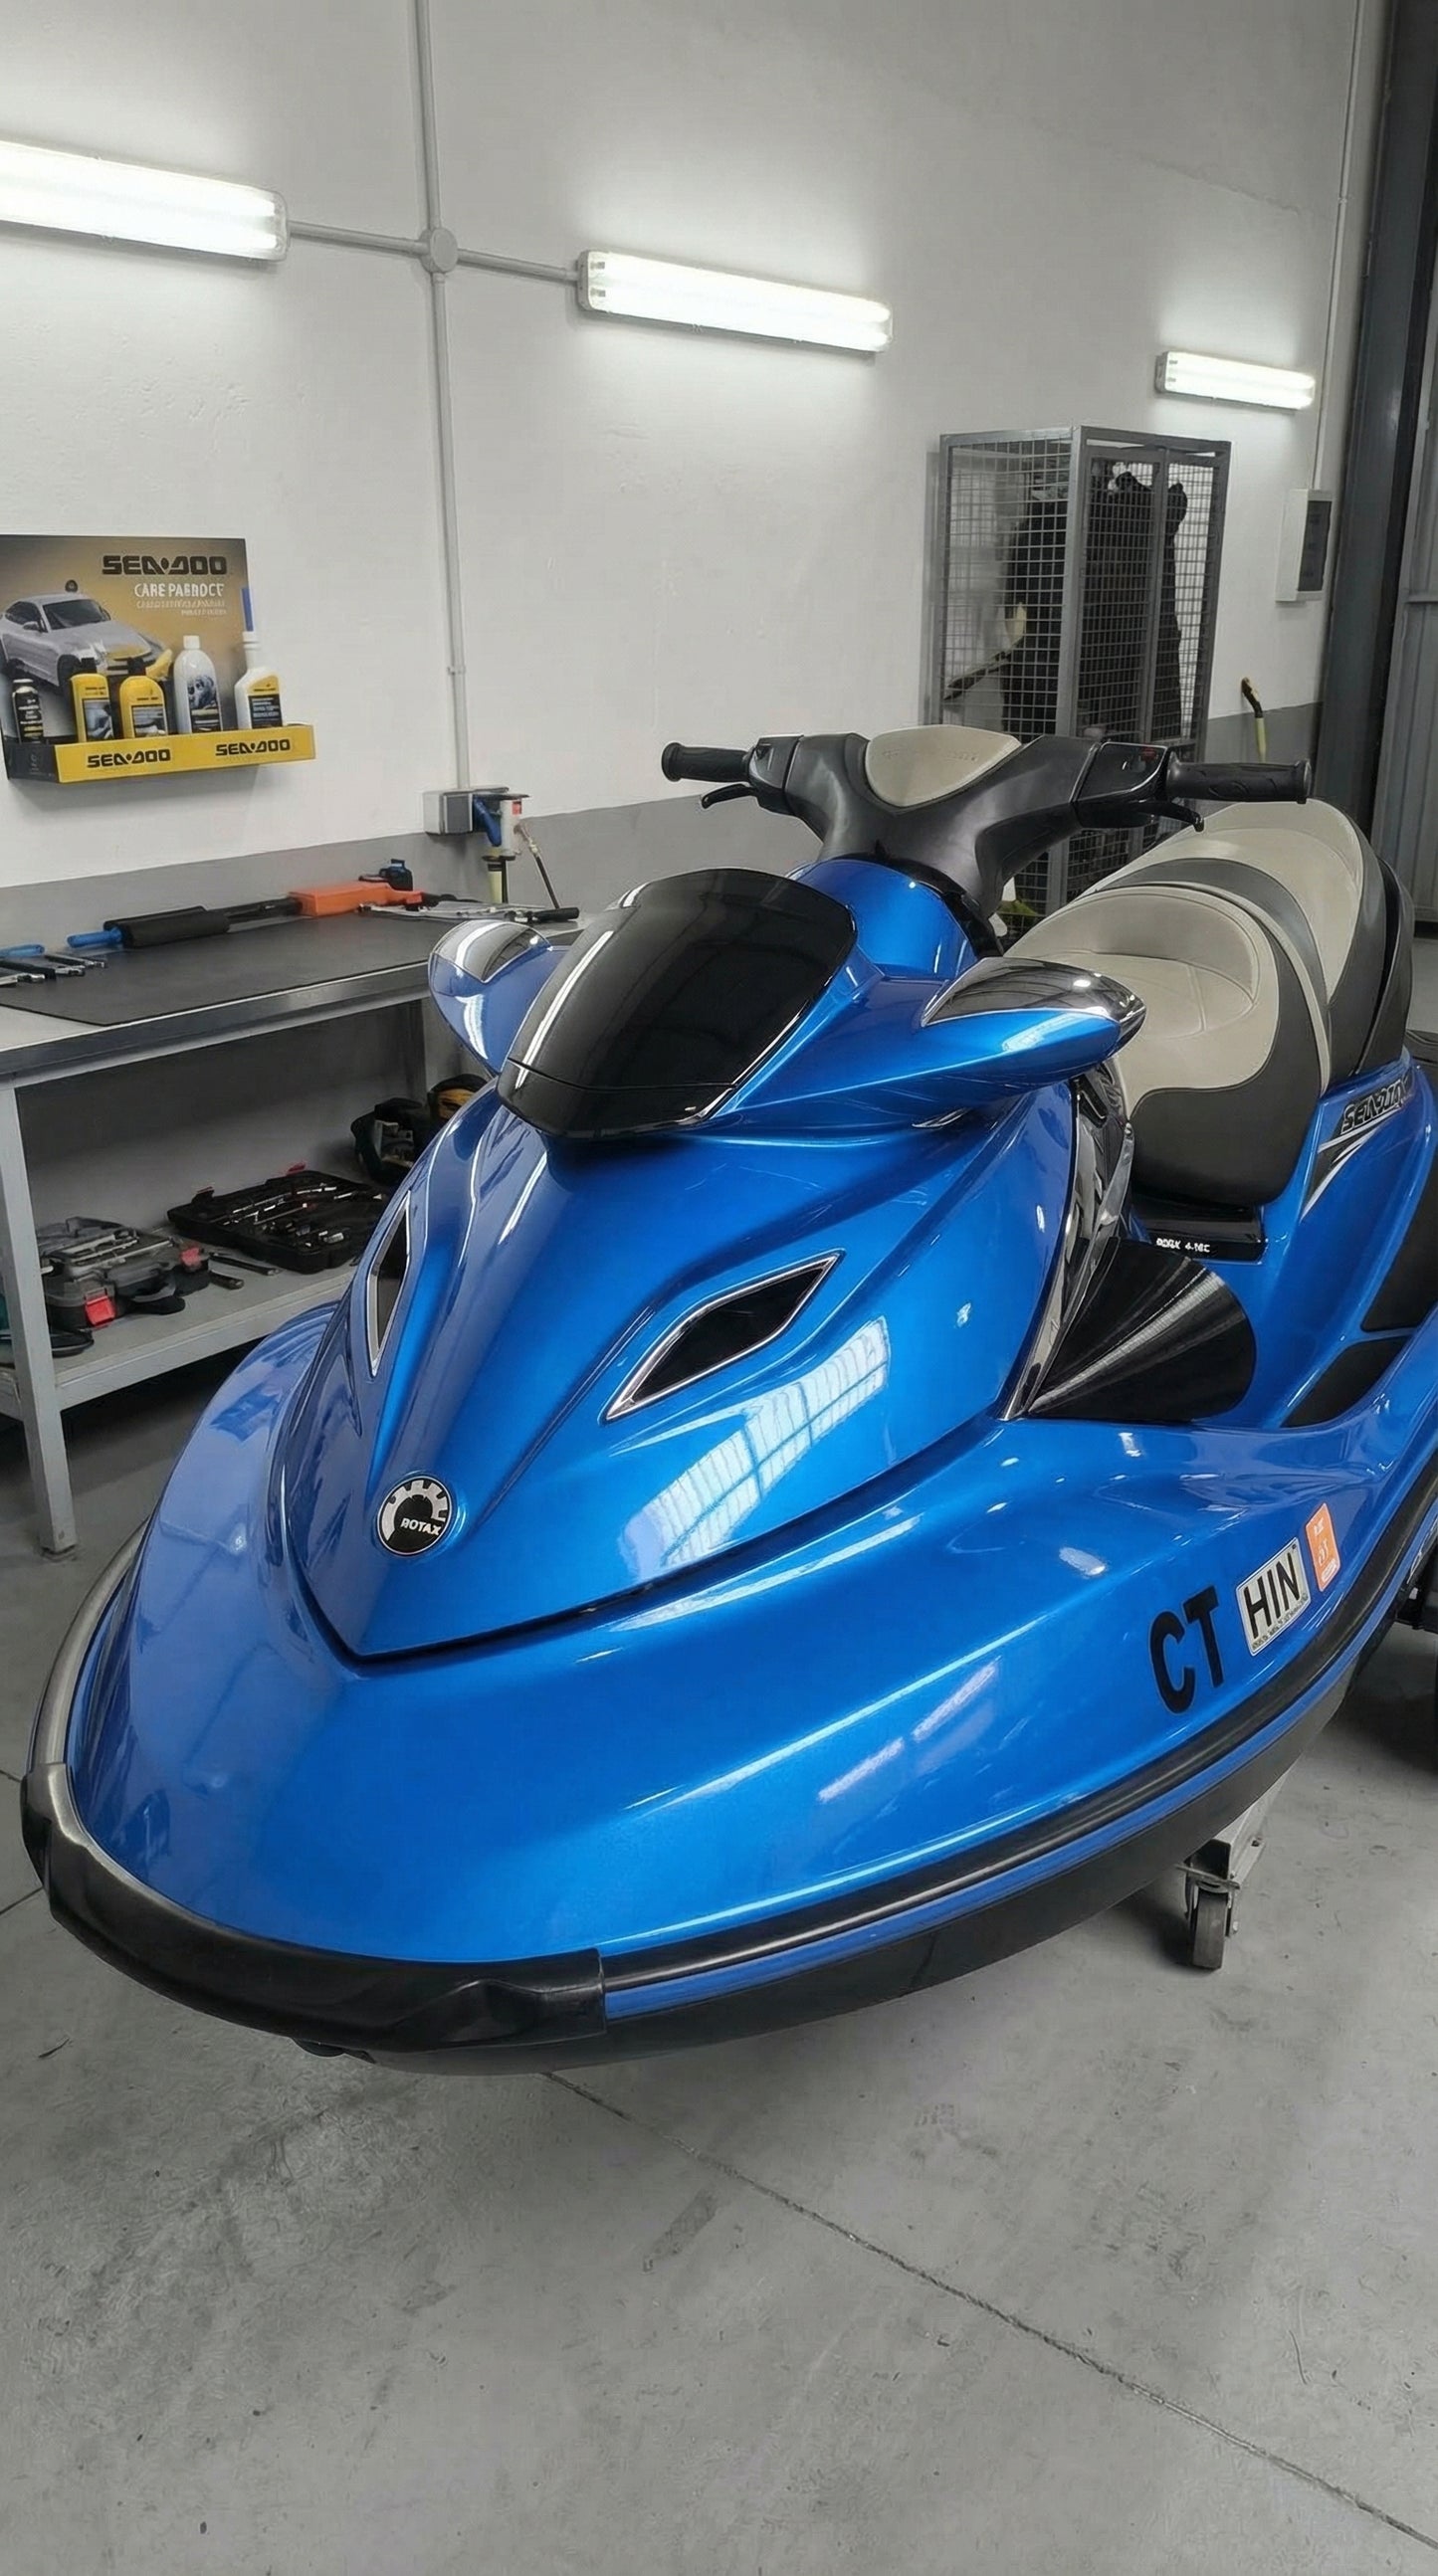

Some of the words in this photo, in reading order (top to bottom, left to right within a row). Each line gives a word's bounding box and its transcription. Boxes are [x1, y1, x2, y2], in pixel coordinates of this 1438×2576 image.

[134, 582, 165, 598] CARE
[400, 1517, 442, 1536] ROTAX
[1243, 1552, 1301, 1640] HIN
[1148, 1584, 1224, 1714] CT
